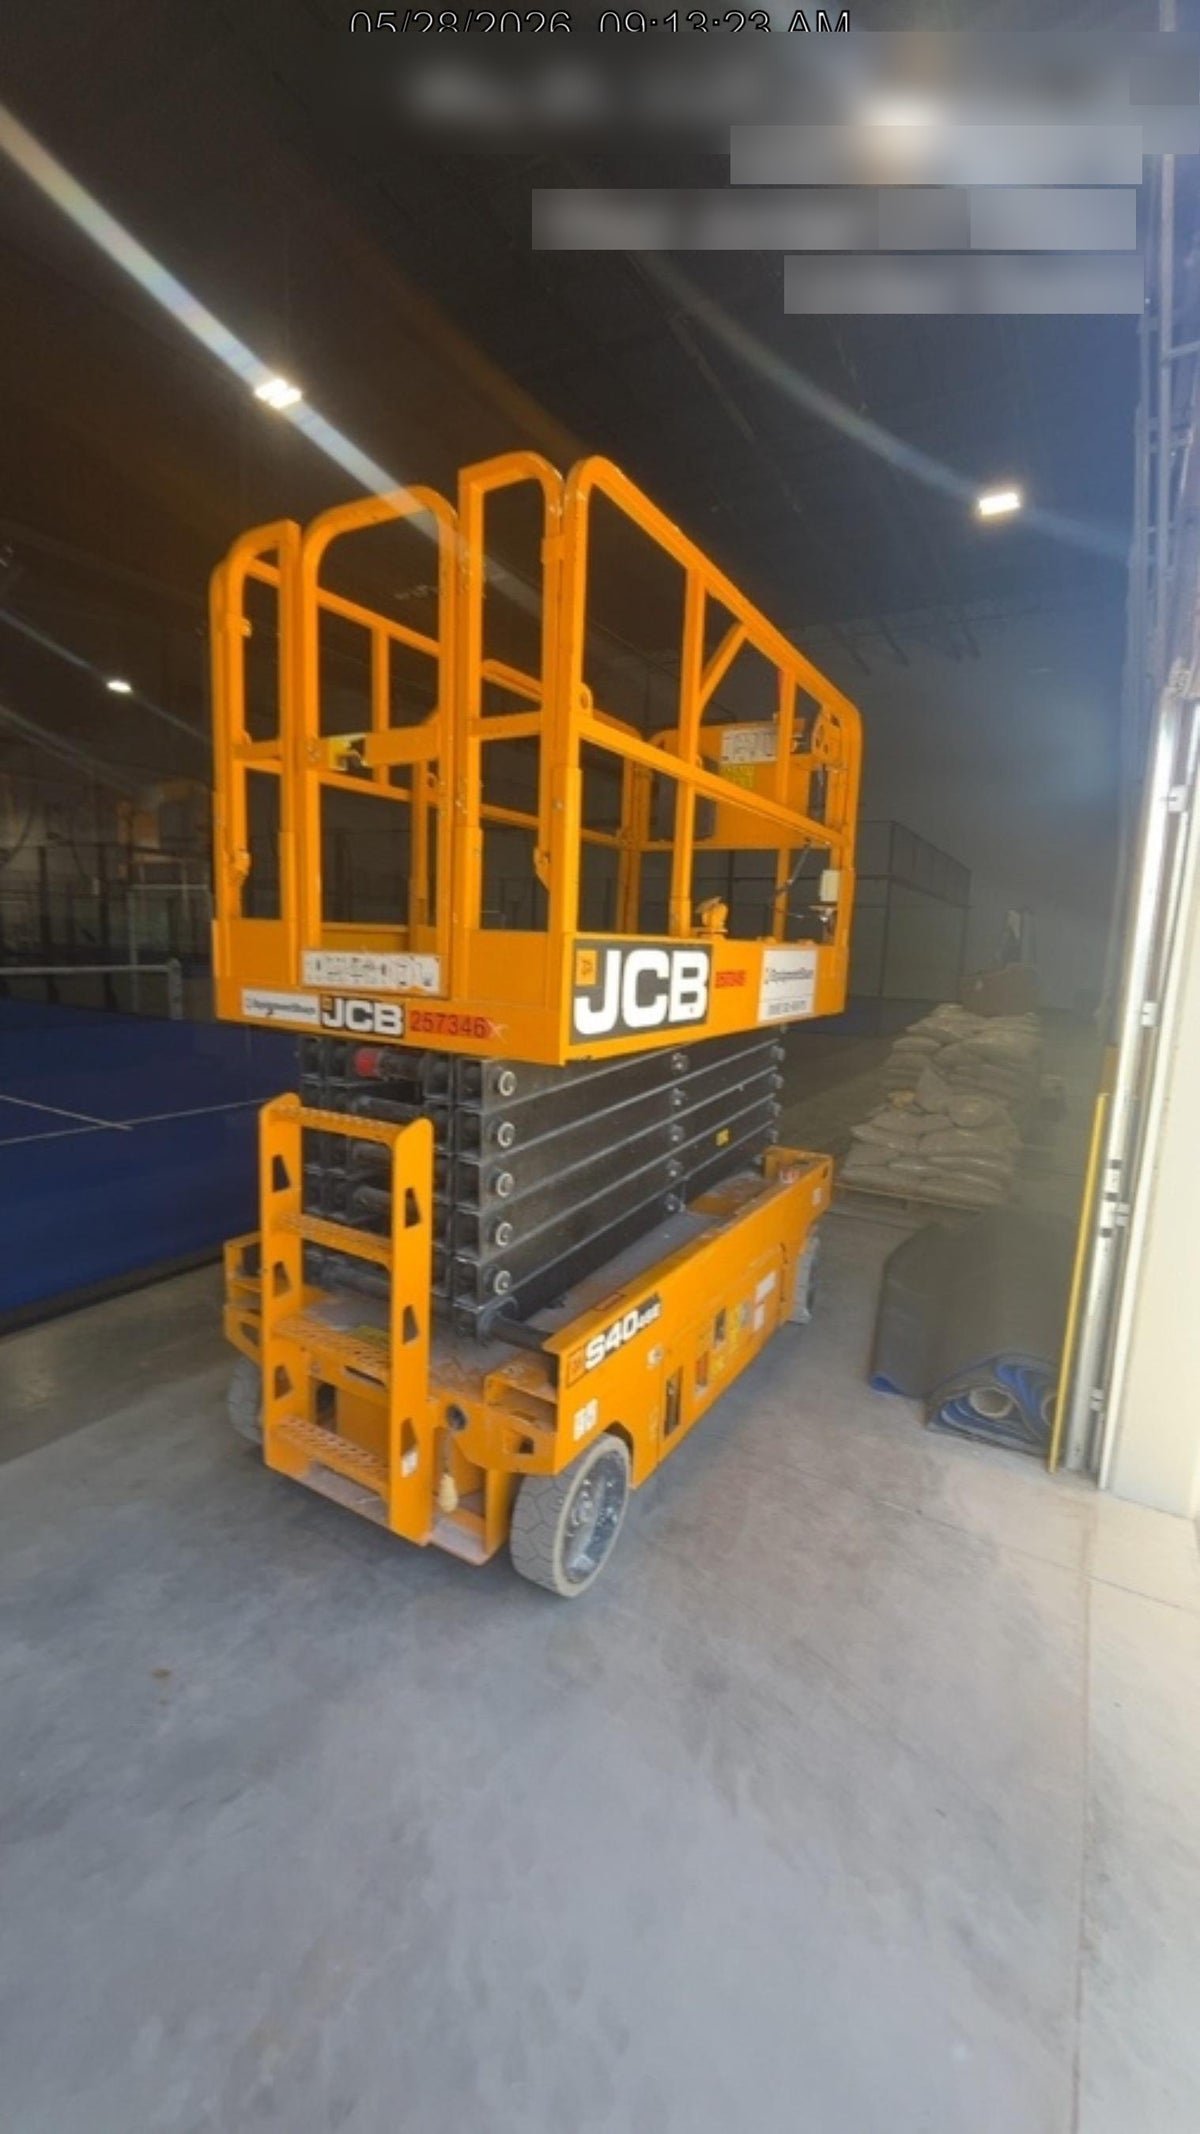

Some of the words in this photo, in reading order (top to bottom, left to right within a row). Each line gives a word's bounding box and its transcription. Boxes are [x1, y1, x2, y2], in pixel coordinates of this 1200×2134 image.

[574, 949, 709, 1035] JCB
[321, 997, 404, 1035] JCB
[410, 1010, 486, 1039] 257346
